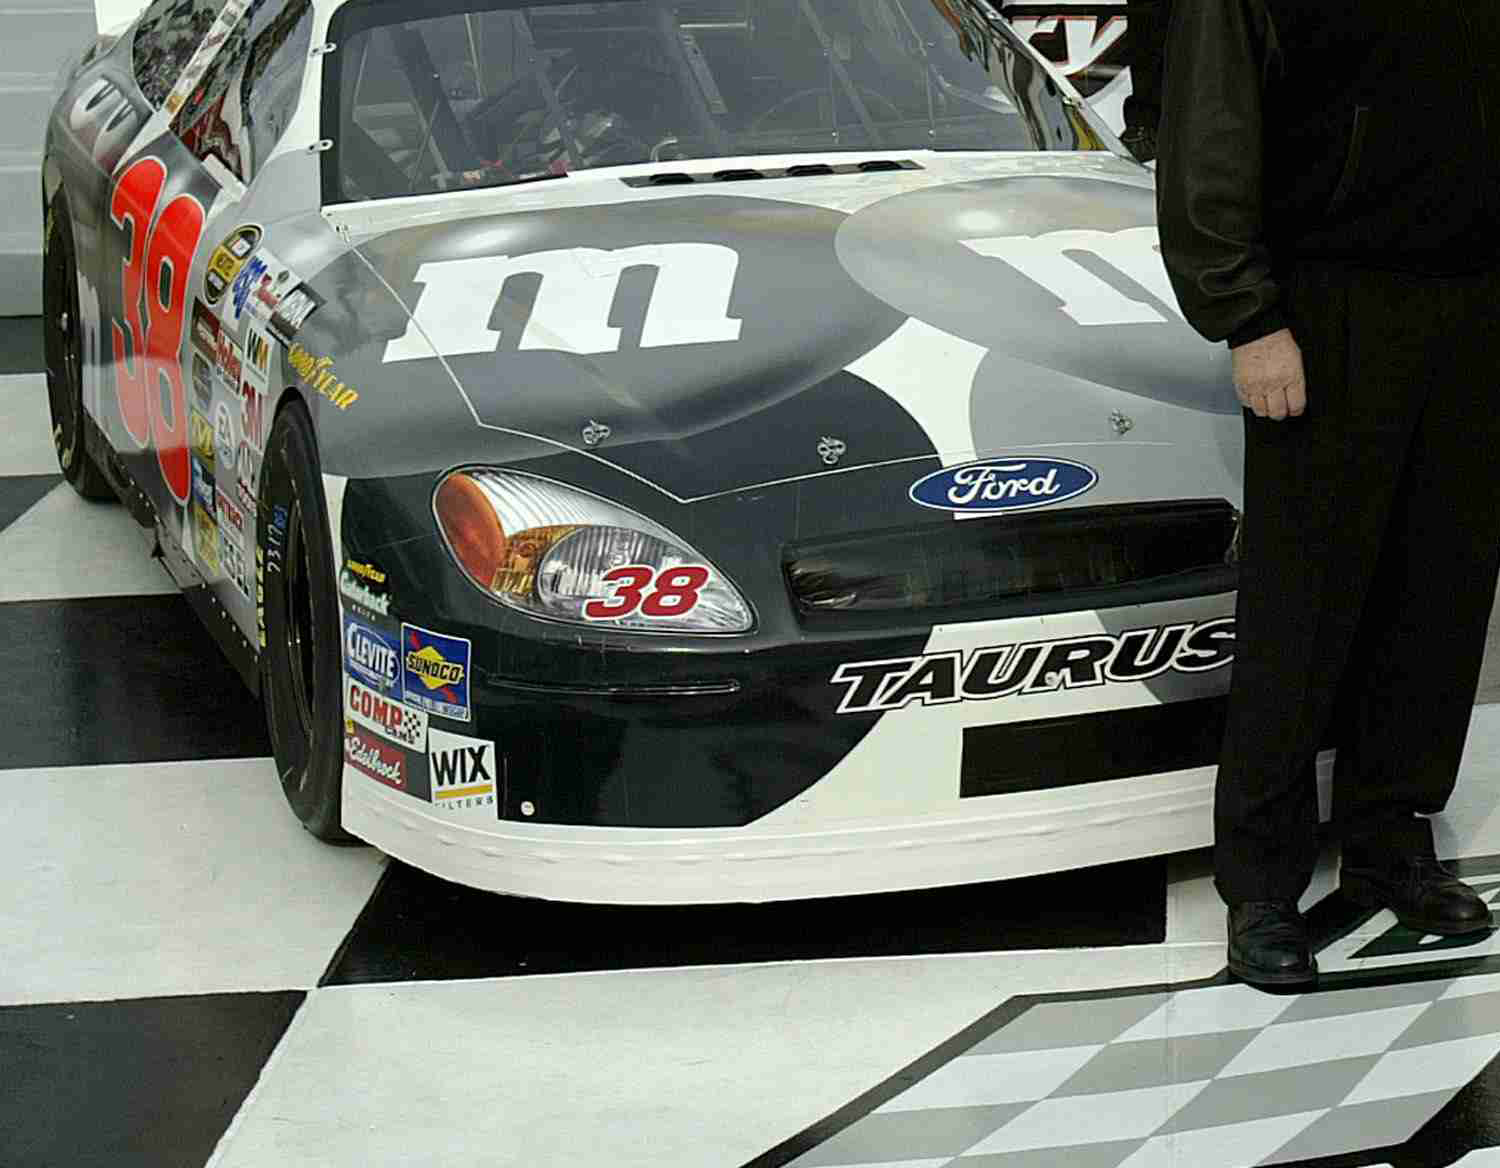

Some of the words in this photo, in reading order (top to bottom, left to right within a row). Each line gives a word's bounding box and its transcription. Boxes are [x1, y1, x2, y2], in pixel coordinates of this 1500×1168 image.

[946, 464, 1060, 503] Ford
[585, 565, 709, 621] 38
[348, 623, 397, 679] CLEVITE
[406, 653, 463, 682] SUNOCO
[830, 617, 1238, 715] TAURUS
[351, 685, 402, 734] COMP
[350, 738, 403, 785] Edelbrock
[431, 744, 491, 787] WIX
